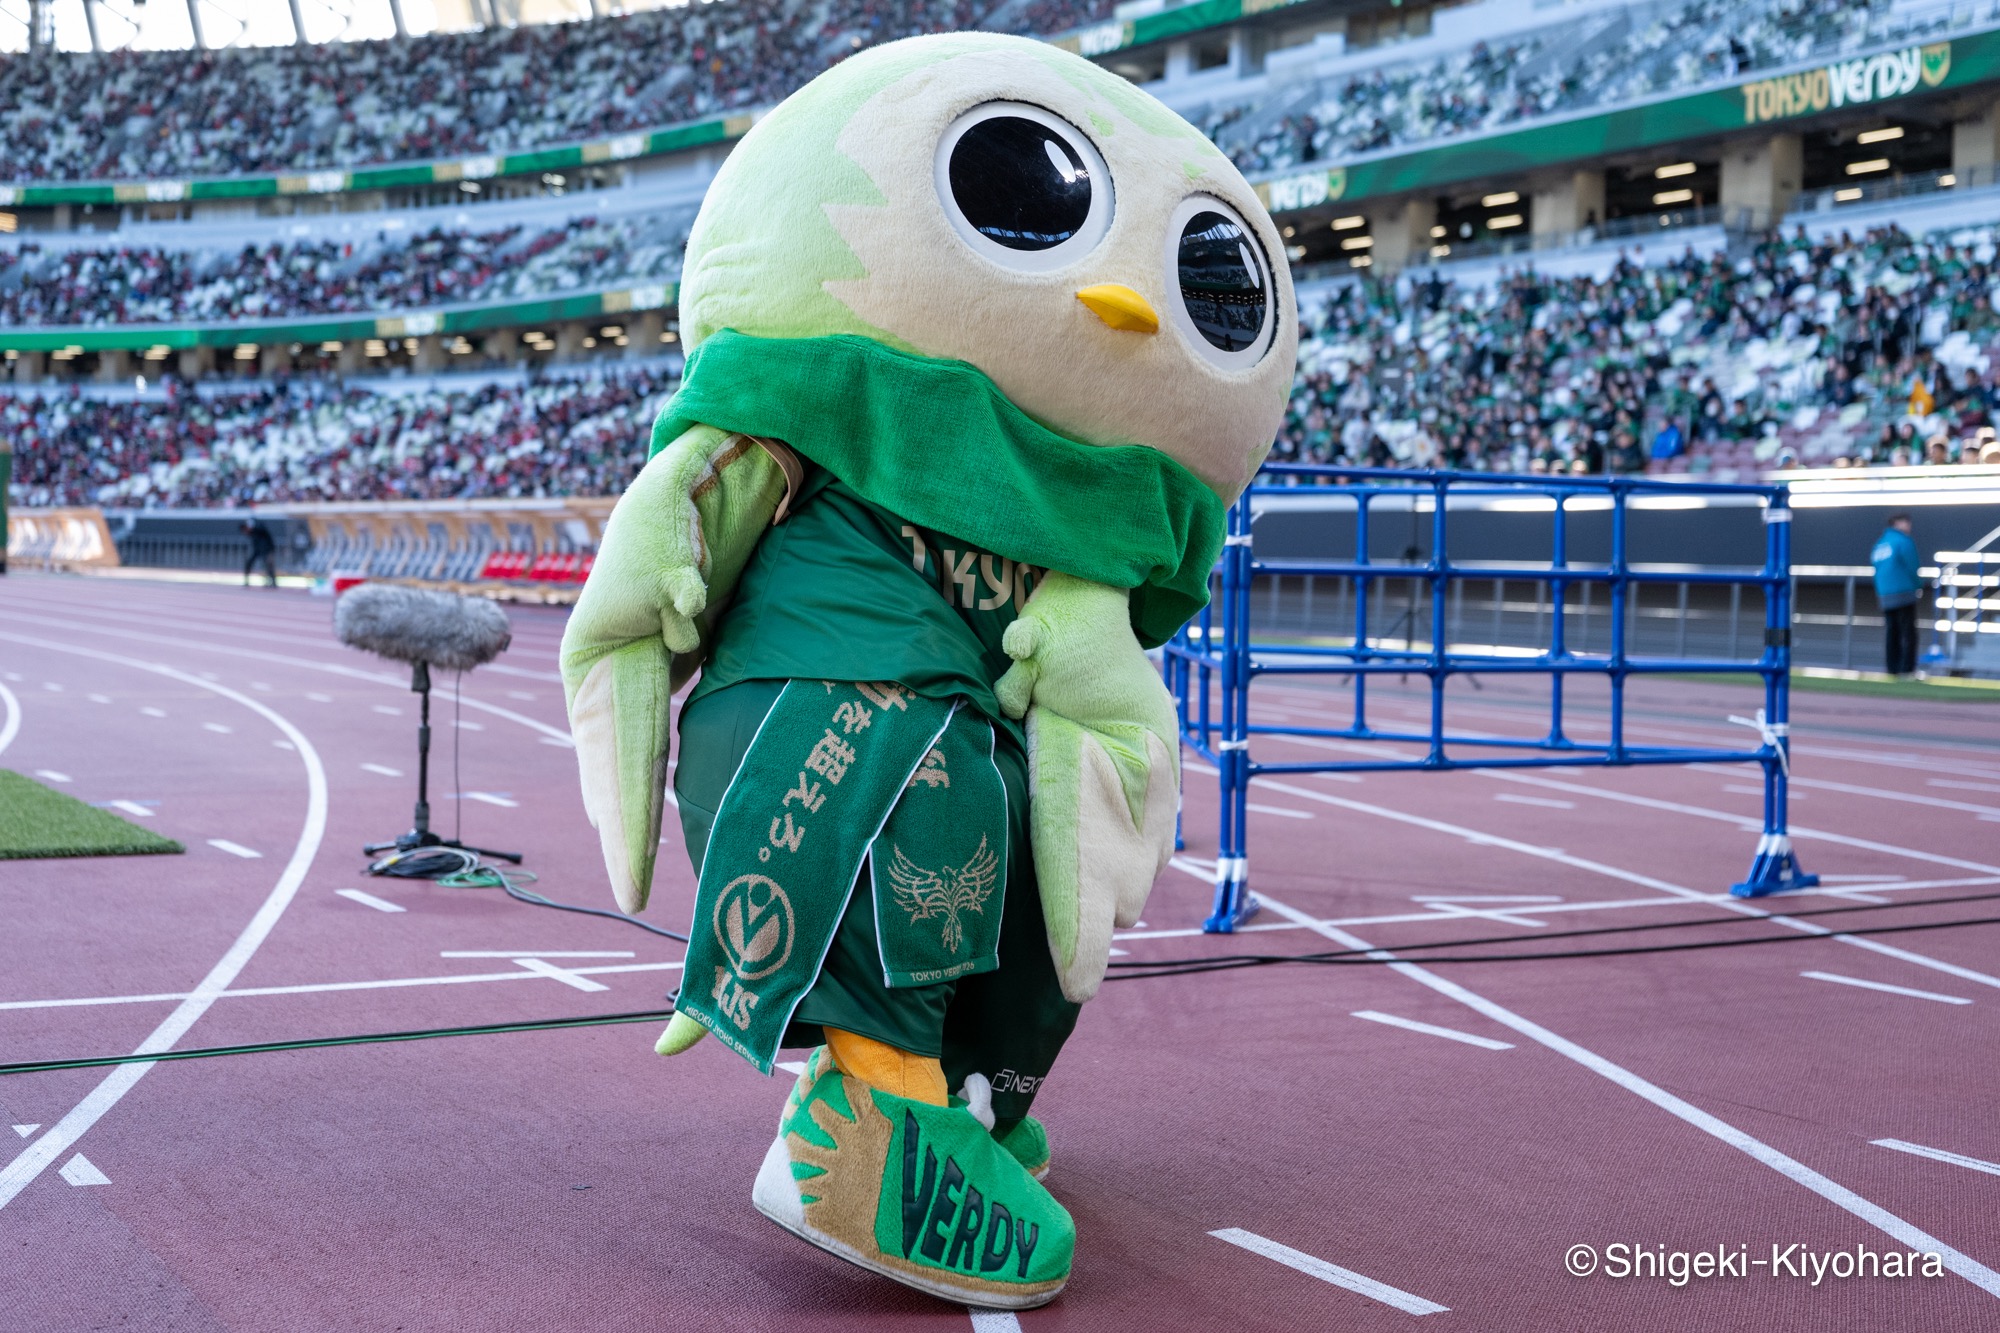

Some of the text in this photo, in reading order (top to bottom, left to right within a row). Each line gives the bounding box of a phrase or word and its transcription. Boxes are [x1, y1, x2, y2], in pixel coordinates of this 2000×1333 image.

[901, 526, 1041, 616] TKYO
[910, 970, 942, 982] TOKYO
[684, 1005, 761, 1069] MIROKU JYOHO SERVICE
[902, 1106, 1039, 1279] VERDY
